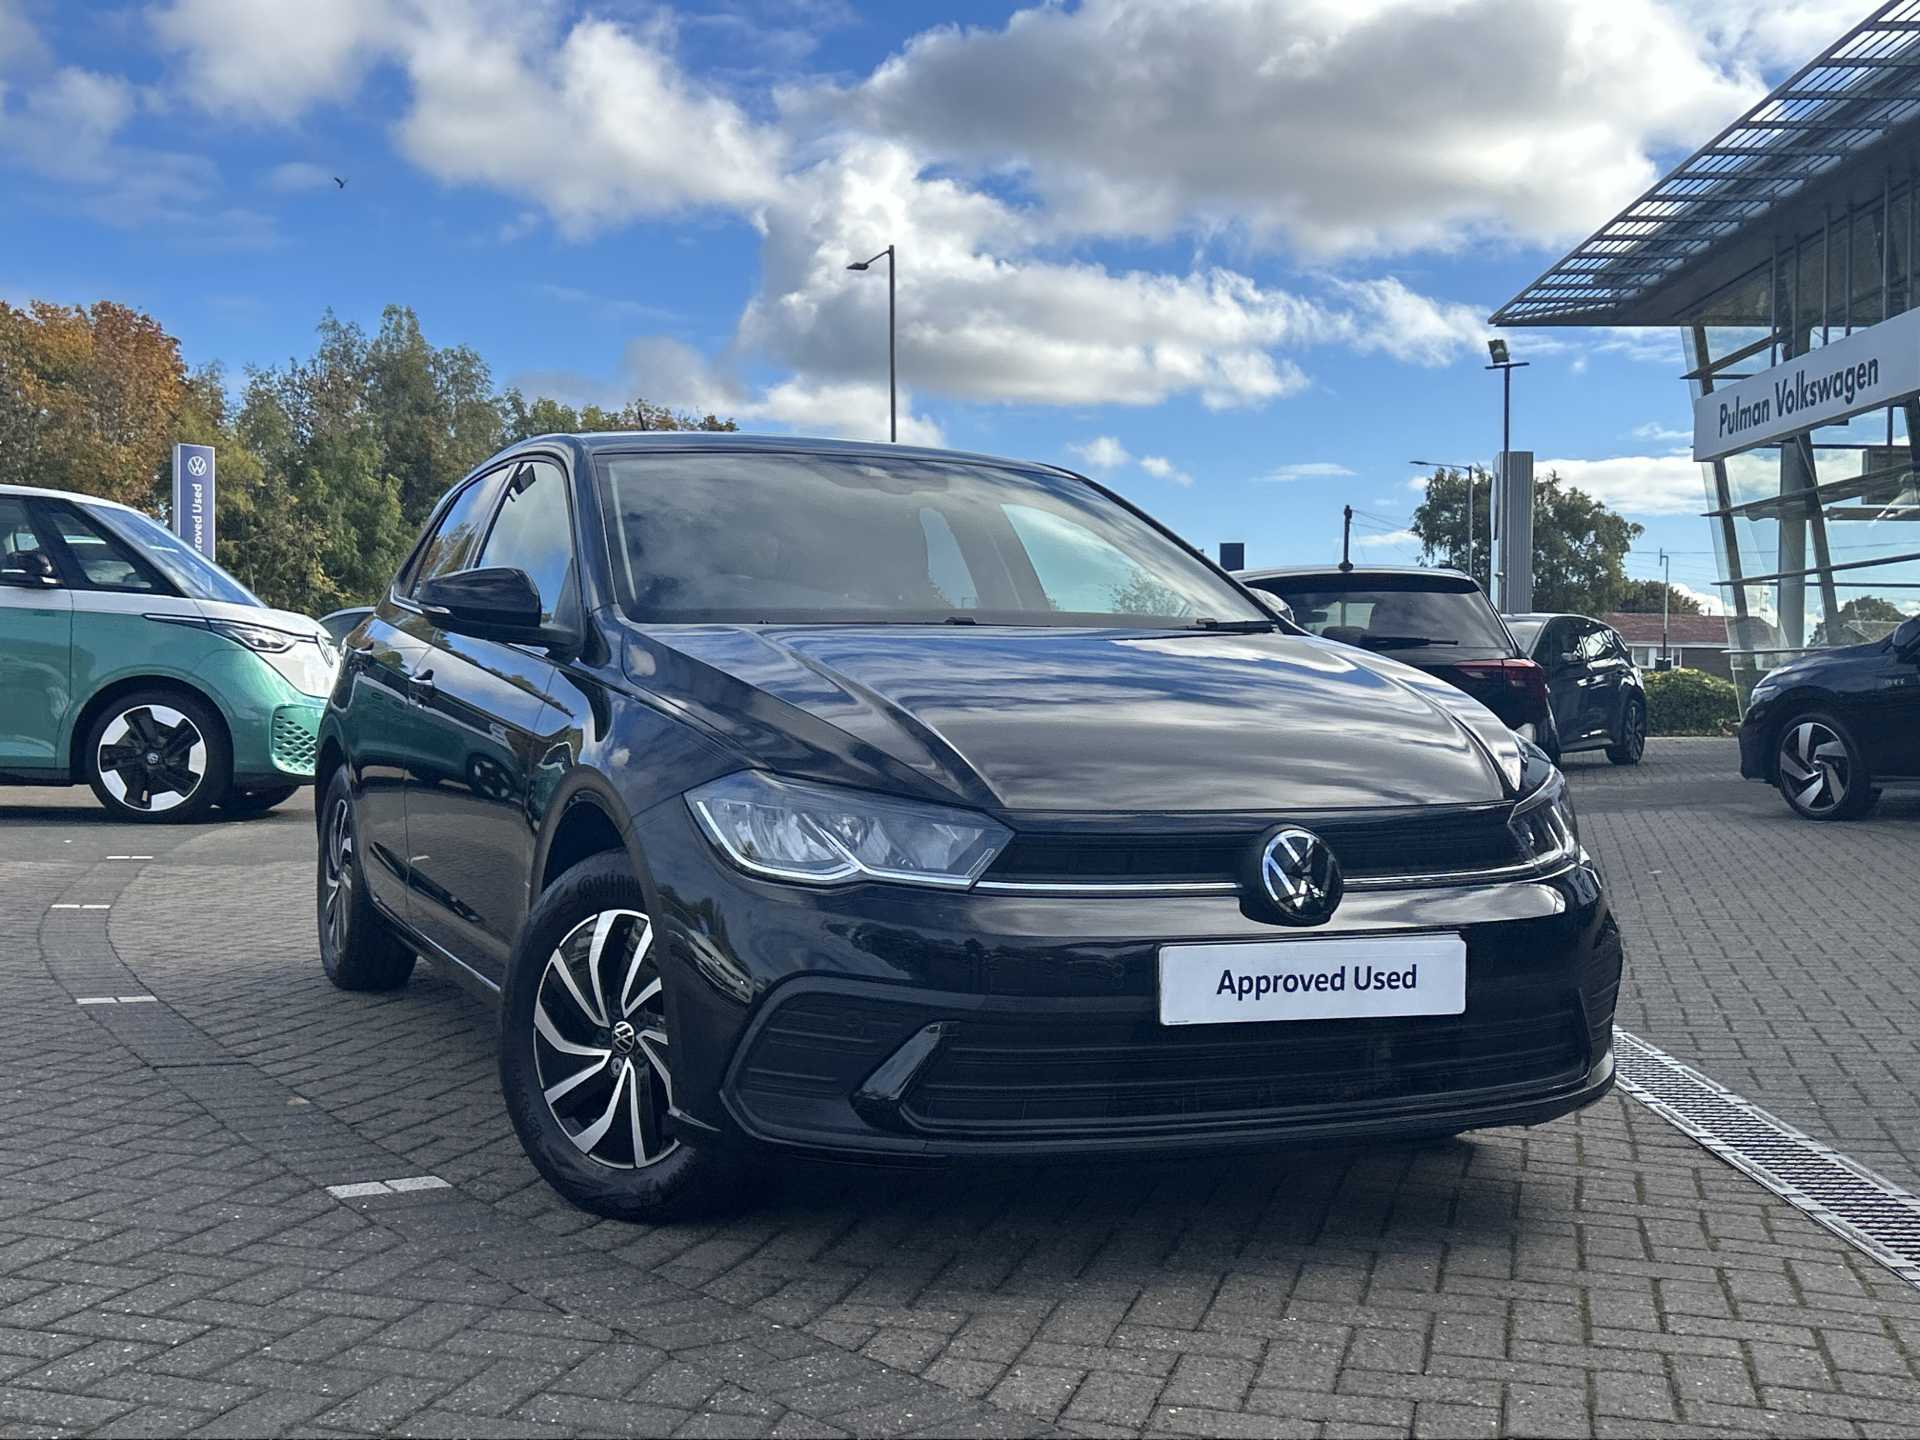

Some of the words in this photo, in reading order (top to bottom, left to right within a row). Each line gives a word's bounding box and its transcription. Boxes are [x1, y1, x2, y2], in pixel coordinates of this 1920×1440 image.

[1719, 396, 1770, 438] Pulman
[1775, 358, 1879, 418] Volkswagen
[191, 483, 203, 513] Used
[191, 515, 203, 552] roved
[1216, 965, 1346, 1001] Approved
[1353, 963, 1418, 991] Used
